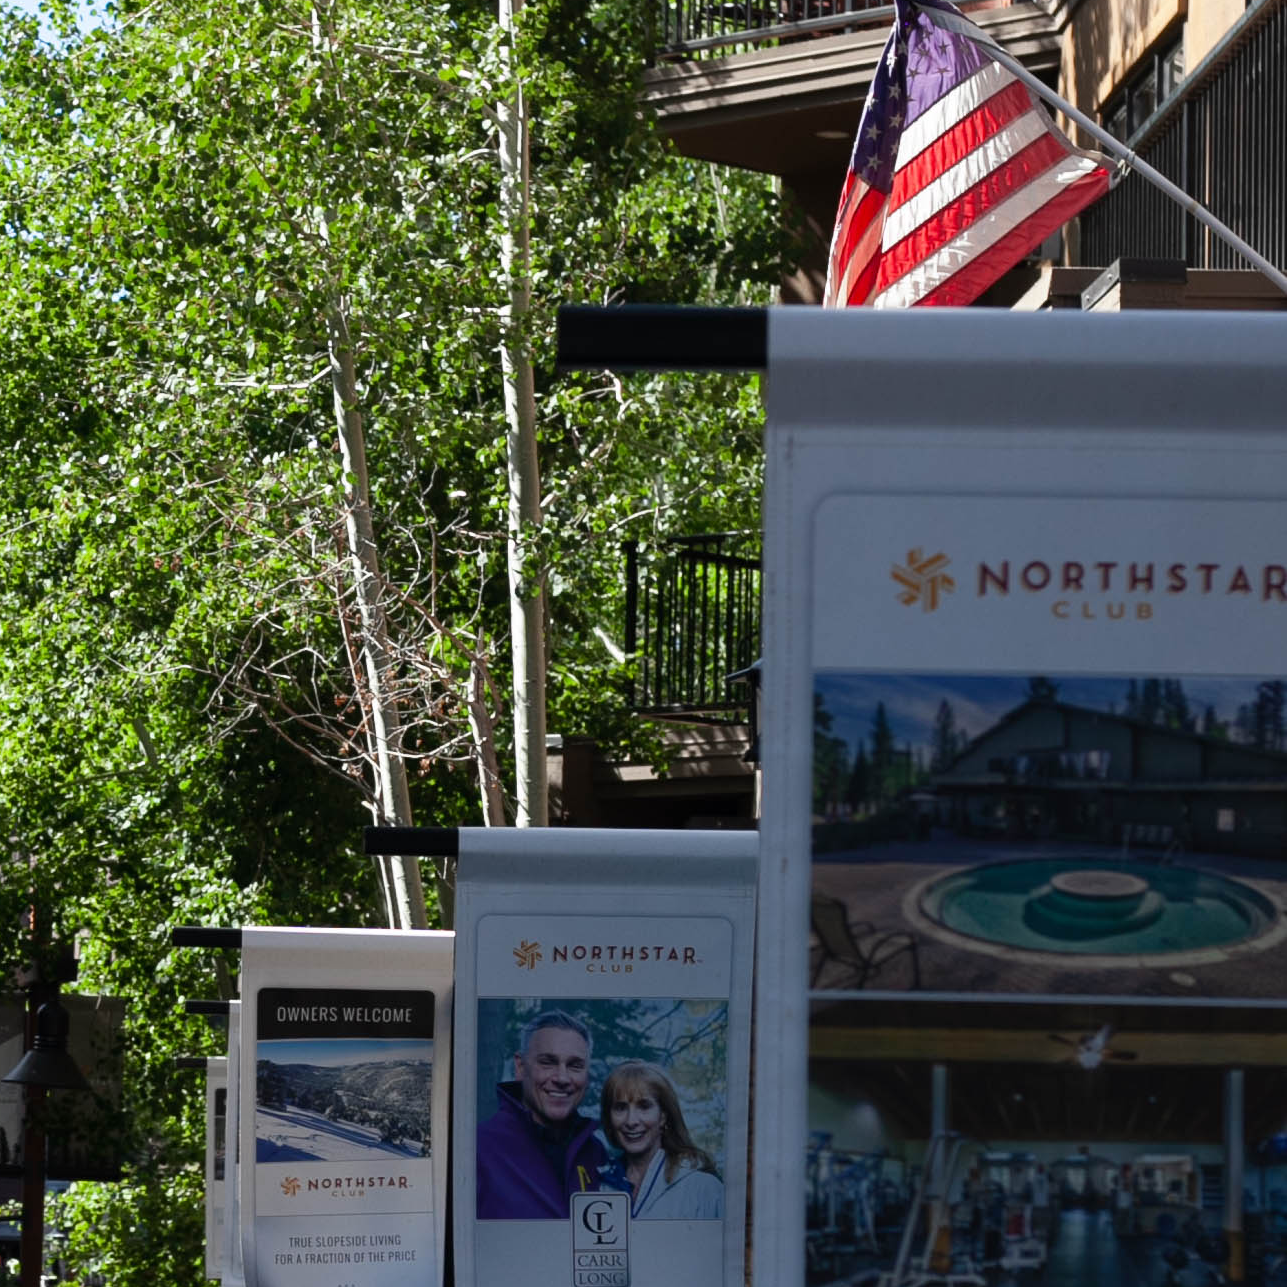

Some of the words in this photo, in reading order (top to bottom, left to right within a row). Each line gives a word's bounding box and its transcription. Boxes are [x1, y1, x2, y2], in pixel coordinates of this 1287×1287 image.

[978, 560, 1287, 602] NORTHSTAR
[1051, 601, 1154, 620] CLUB
[553, 945, 696, 964] NORTHSTAR
[586, 964, 634, 973] CLUB
[276, 1006, 338, 1022] OWNERS
[342, 1006, 412, 1023] WELCOME
[307, 1176, 409, 1191] NORTHSTAR
[289, 1236, 313, 1249] TRUE
[315, 1235, 367, 1248] SLOPESIDE
[370, 1234, 402, 1246] LIVING
[274, 1253, 293, 1265] FOR
[296, 1253, 302, 1264] A
[305, 1252, 351, 1264] FRACTION
[353, 1252, 366, 1263] OF
[368, 1251, 386, 1263] THE
[388, 1249, 417, 1262] PRICE
[577, 1255, 623, 1267] CARR
[578, 1272, 625, 1285] LONG
